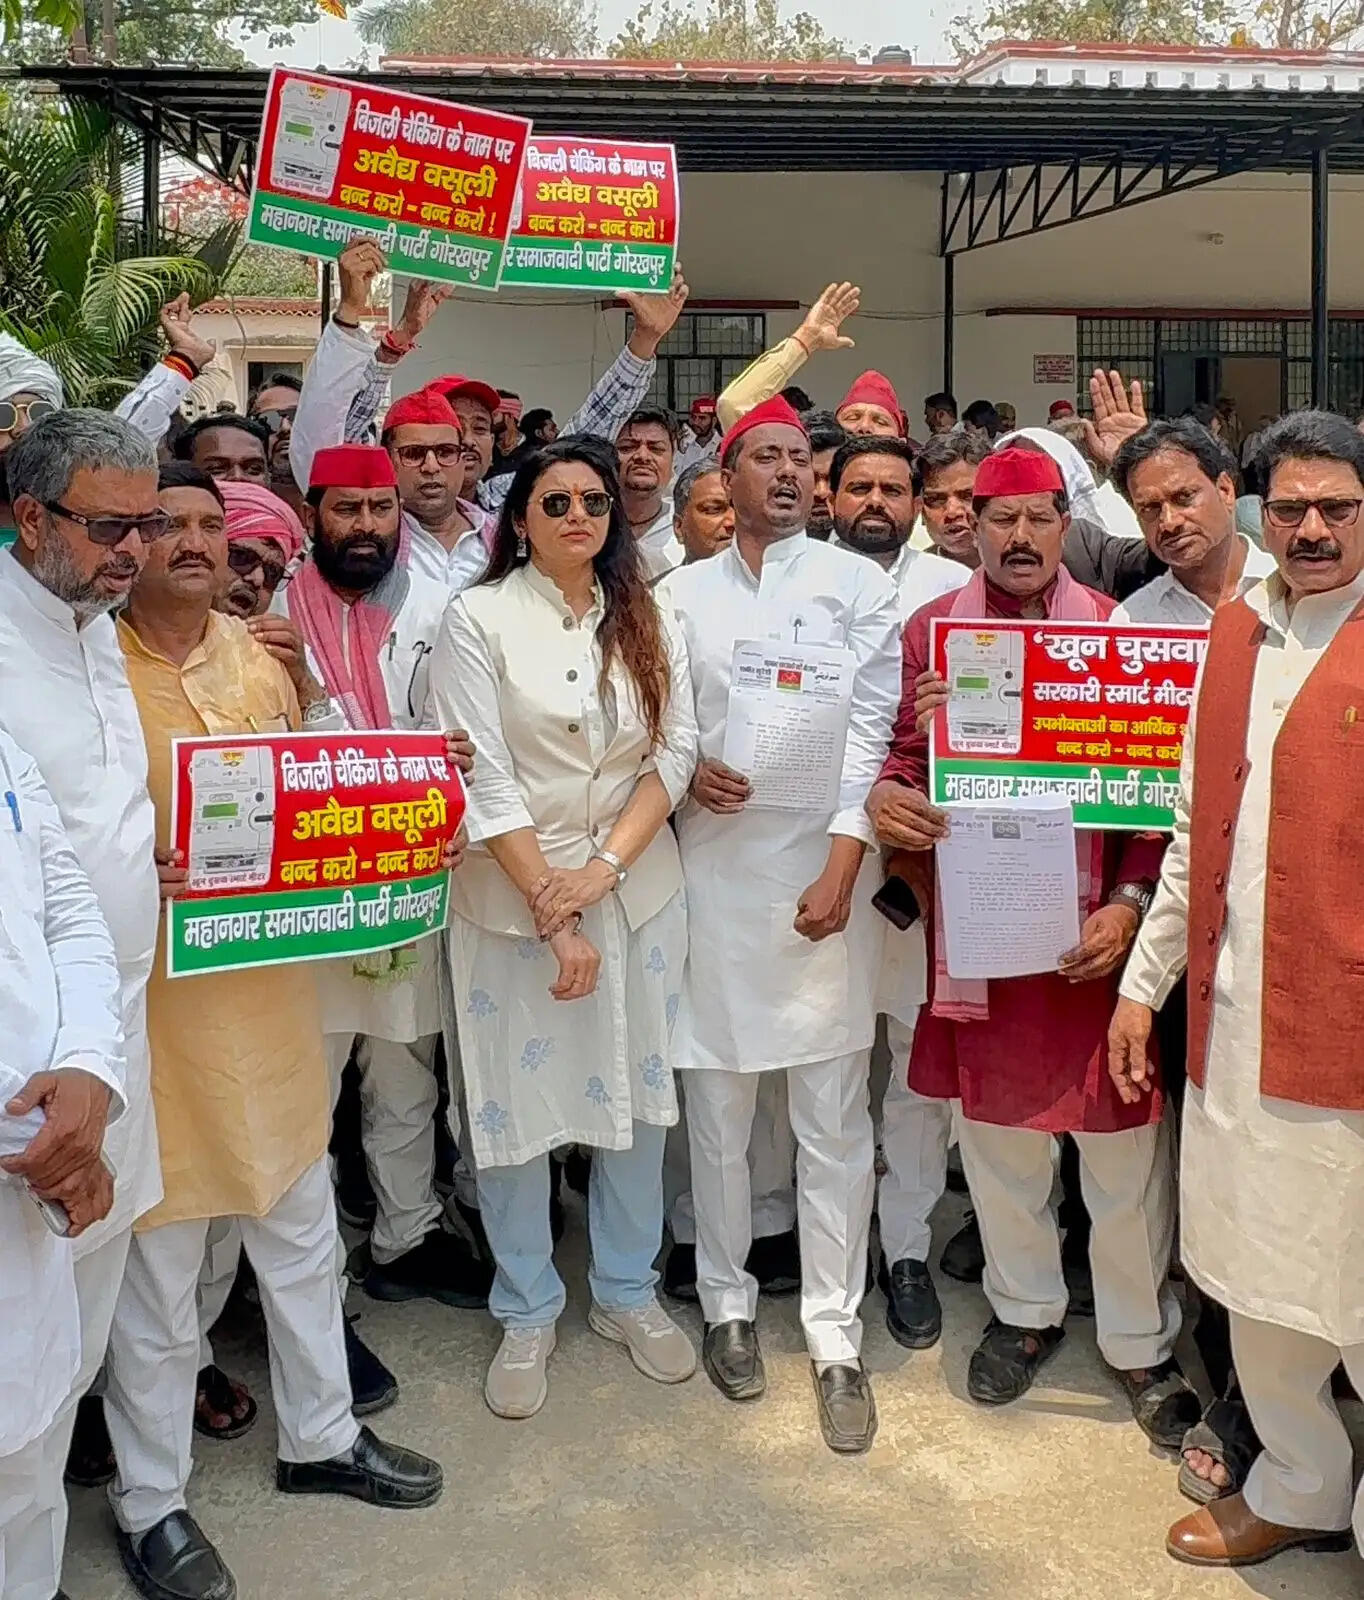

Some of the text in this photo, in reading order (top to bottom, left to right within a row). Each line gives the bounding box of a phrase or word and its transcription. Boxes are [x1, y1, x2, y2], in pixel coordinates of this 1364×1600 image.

[353, 99, 515, 164] बिजली चेकिंग के नाम पर
[526, 145, 666, 179] बिजली चेकिंग के नाम पर
[423, 165, 498, 204] वसूली
[595, 181, 659, 217] वसूली
[340, 184, 372, 208] बन्द
[373, 189, 404, 215] करो
[420, 201, 453, 225] बन्द
[454, 206, 485, 231] करो
[527, 214, 557, 232] बन्द
[559, 211, 585, 234] करो
[600, 218, 627, 237] बन्द
[629, 215, 656, 239] करो
[261, 204, 323, 238] महानगर
[400, 229, 431, 259] पार्टी
[430, 234, 493, 281] गोरखपुर
[516, 241, 583, 270] समाजवादी
[586, 243, 612, 272] पार्टी
[613, 245, 666, 286] गोरखपुर
[1033, 676, 1101, 703] सरकारी
[1104, 678, 1151, 704] स्मार्ट
[1109, 719, 1129, 734] का
[1131, 716, 1178, 736] आर्थिक
[1056, 741, 1083, 755] बन्द
[1085, 738, 1112, 757] करो
[1126, 744, 1153, 758] बन्द
[281, 747, 450, 792] बिजली चेकिंग के नाम पर
[944, 773, 1015, 800] महानगर
[1105, 769, 1141, 806] पार्टी
[370, 787, 448, 844] वसूली
[280, 859, 319, 884] बन्द
[322, 846, 358, 881] करो
[376, 849, 410, 875] बन्द
[412, 838, 441, 869] करो
[183, 883, 444, 949] महानगर समाजवादी पार्टी गोरखपुर
